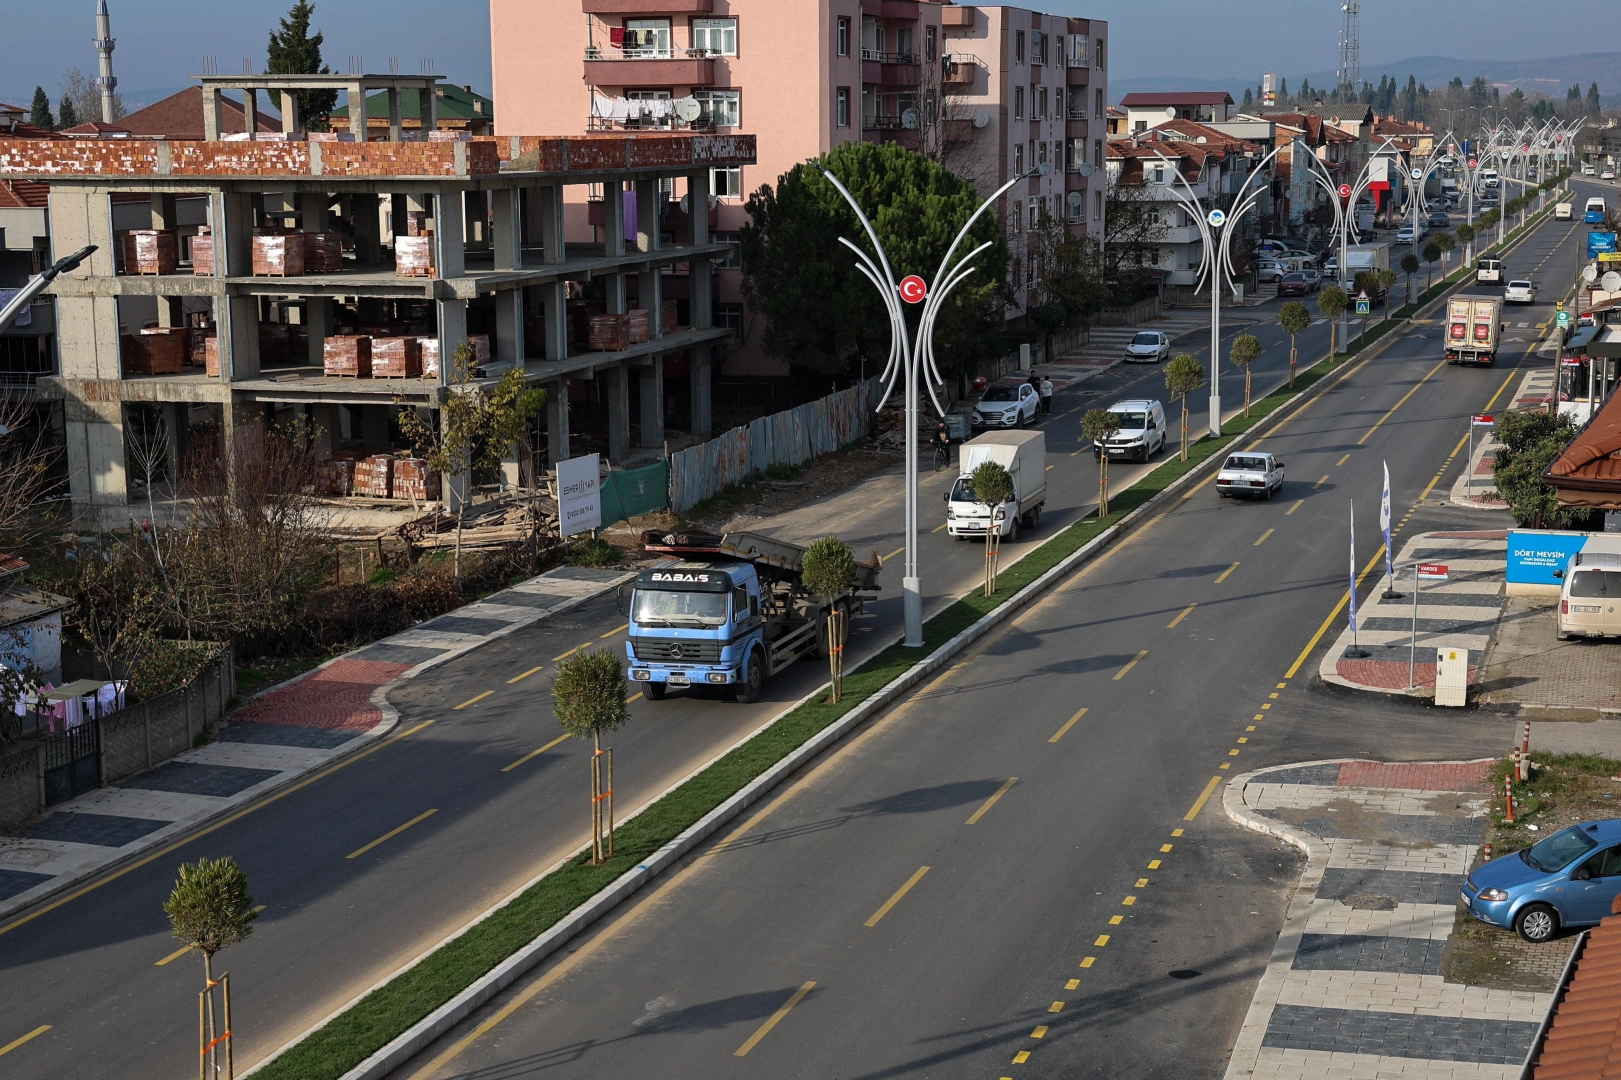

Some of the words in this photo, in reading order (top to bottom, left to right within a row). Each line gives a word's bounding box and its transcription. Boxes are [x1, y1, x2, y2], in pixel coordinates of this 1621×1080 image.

[564, 484, 578, 495] ESMER
[585, 480, 595, 489] YAPI
[1514, 549, 1535, 557] DÖRT
[1536, 550, 1564, 558] MEVSİM
